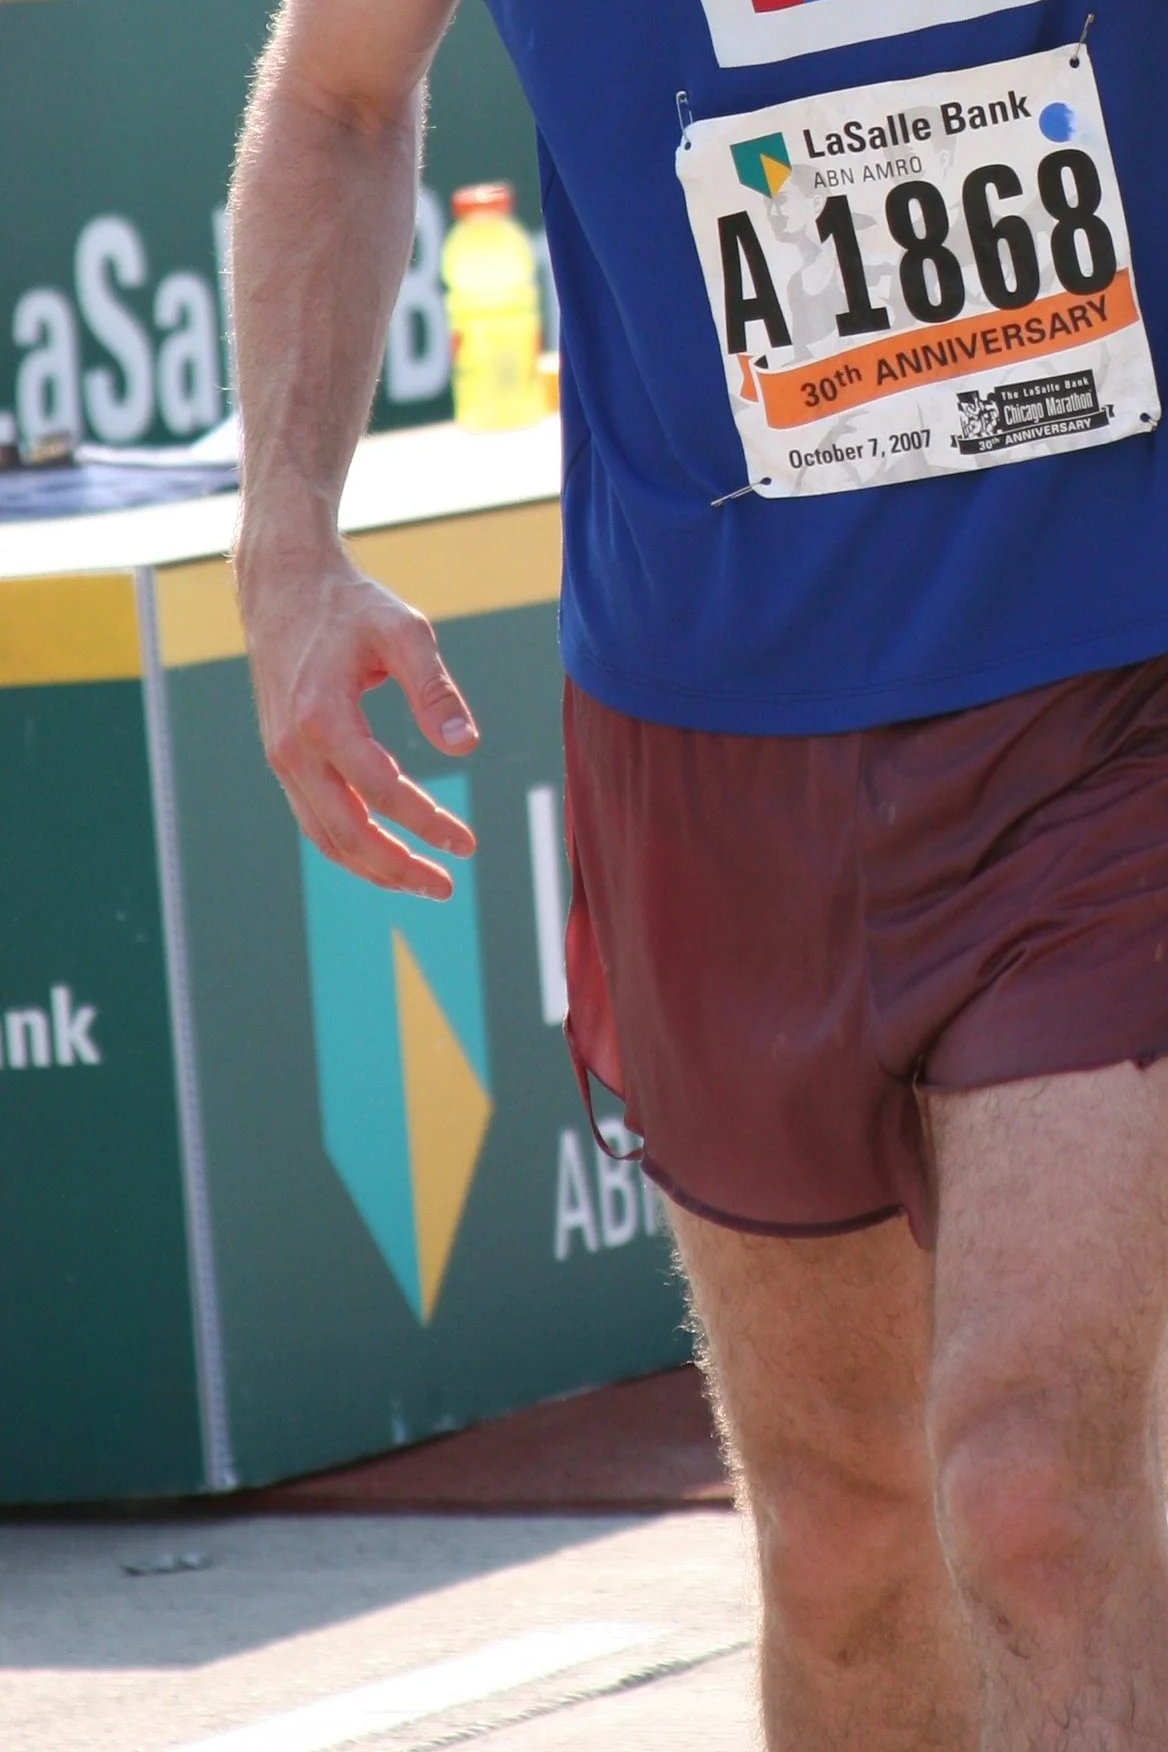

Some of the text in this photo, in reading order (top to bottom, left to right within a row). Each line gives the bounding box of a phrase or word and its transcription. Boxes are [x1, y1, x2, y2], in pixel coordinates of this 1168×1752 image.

[803, 90, 1032, 159] LaSalle Bank
[814, 156, 923, 189] ABN AMRO
[717, 148, 1117, 355] A 1868
[800, 295, 1110, 408] 30th ANNIVERSARY
[1001, 376, 1090, 401] The LaSalle Bank
[1003, 391, 1094, 426] Chicago Marathon
[788, 429, 931, 469] October 7, 2007
[978, 418, 1093, 451] 30th ANNIVERSARY
